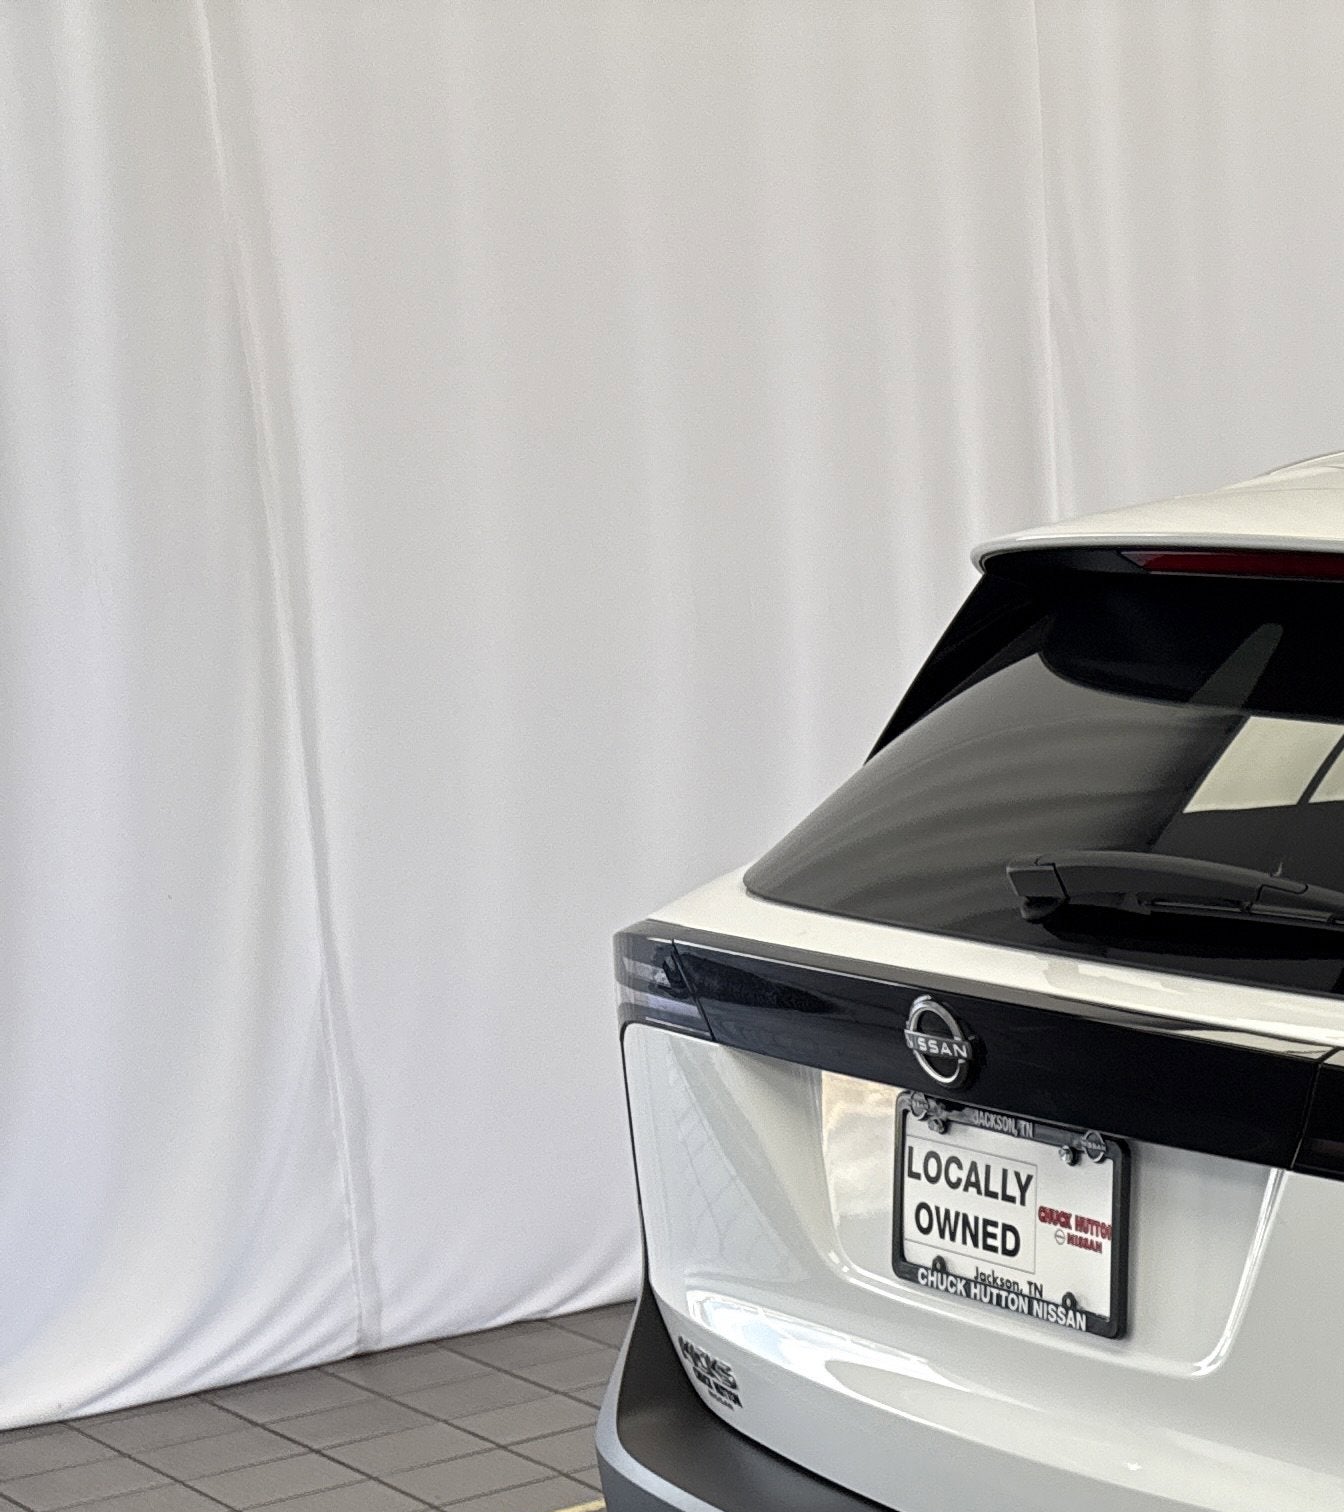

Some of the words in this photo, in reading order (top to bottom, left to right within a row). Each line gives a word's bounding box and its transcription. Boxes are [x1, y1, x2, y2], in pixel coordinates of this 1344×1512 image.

[973, 1110, 1018, 1136] JACKSON,
[1020, 1119, 1034, 1138] TN
[907, 1146, 1034, 1207] LOCALLY
[915, 1202, 1021, 1257] OWNED
[917, 1268, 967, 1297] CHUCK
[970, 1283, 1029, 1314] HUTTON
[1032, 1300, 1087, 1331] NISSAN
[973, 1266, 1024, 1295] Jackson,
[1027, 1280, 1043, 1298] TN
